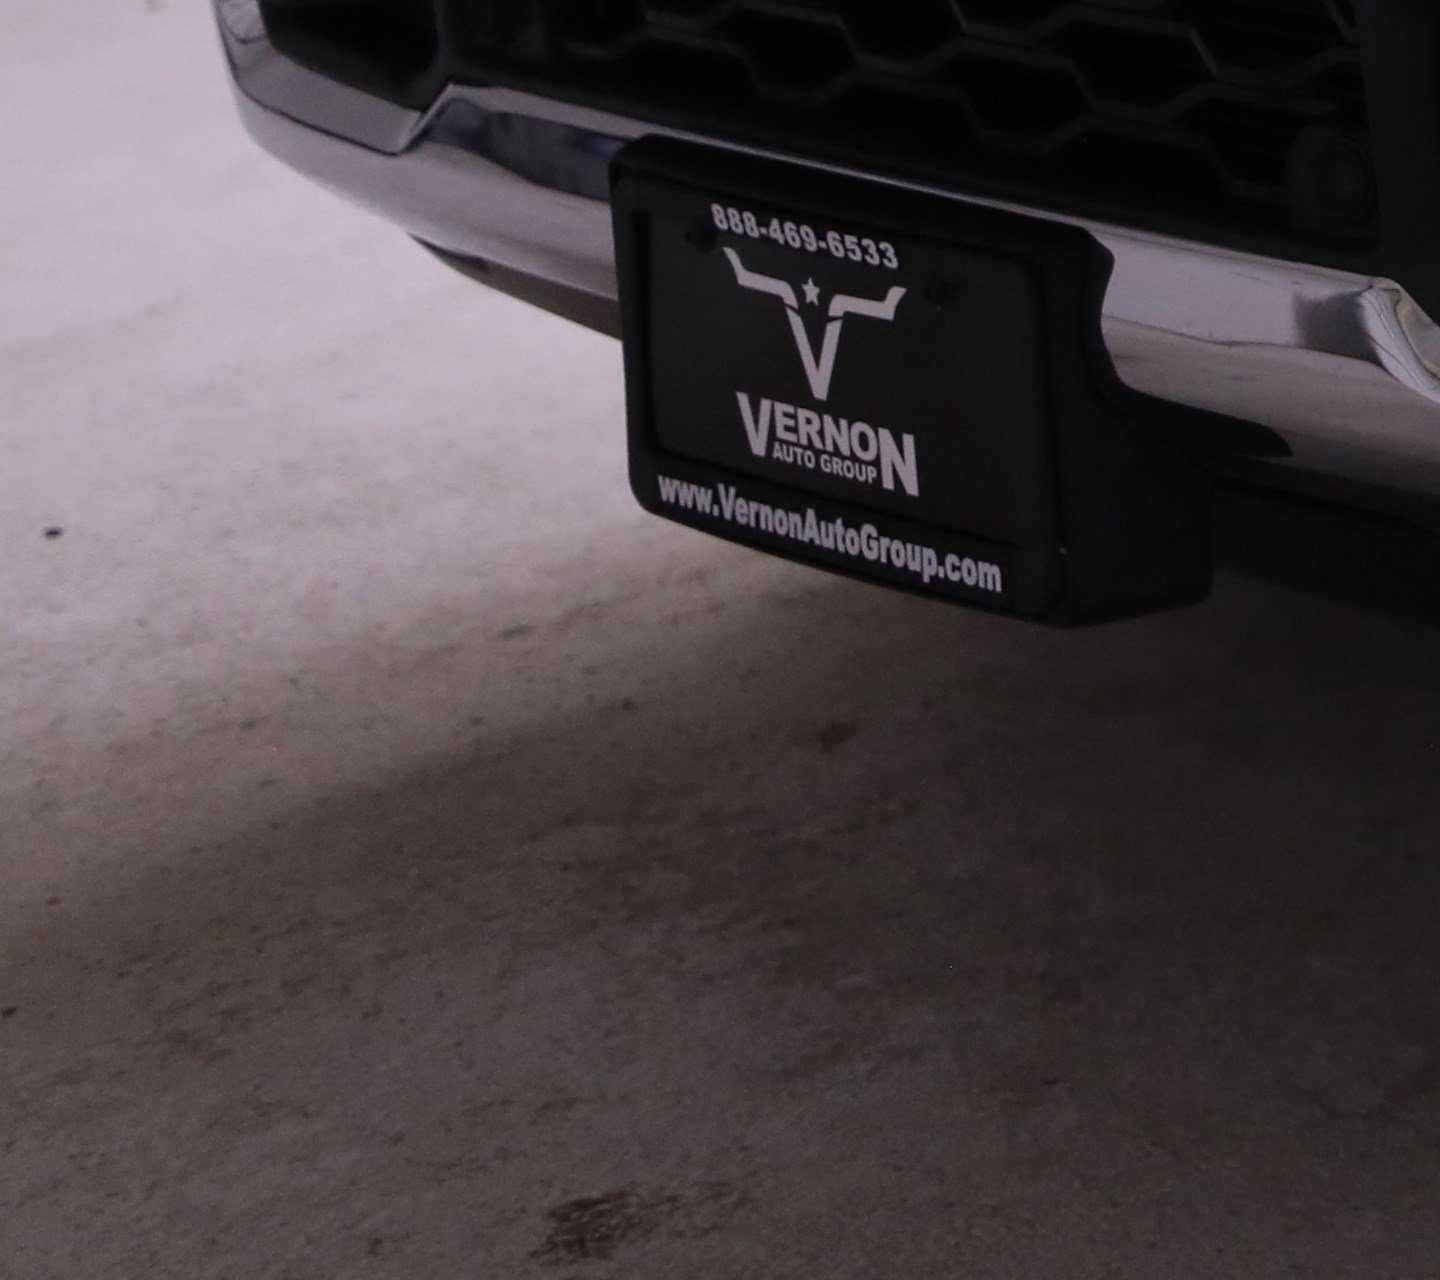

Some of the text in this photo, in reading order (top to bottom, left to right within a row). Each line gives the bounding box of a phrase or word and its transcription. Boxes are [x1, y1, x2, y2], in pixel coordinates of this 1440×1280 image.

[711, 203, 899, 269] 888-469-6533
[736, 390, 920, 497] VERNON
[771, 441, 878, 485] AUTO GROUP
[657, 473, 1003, 593] www.VernonAutoGroup.com
